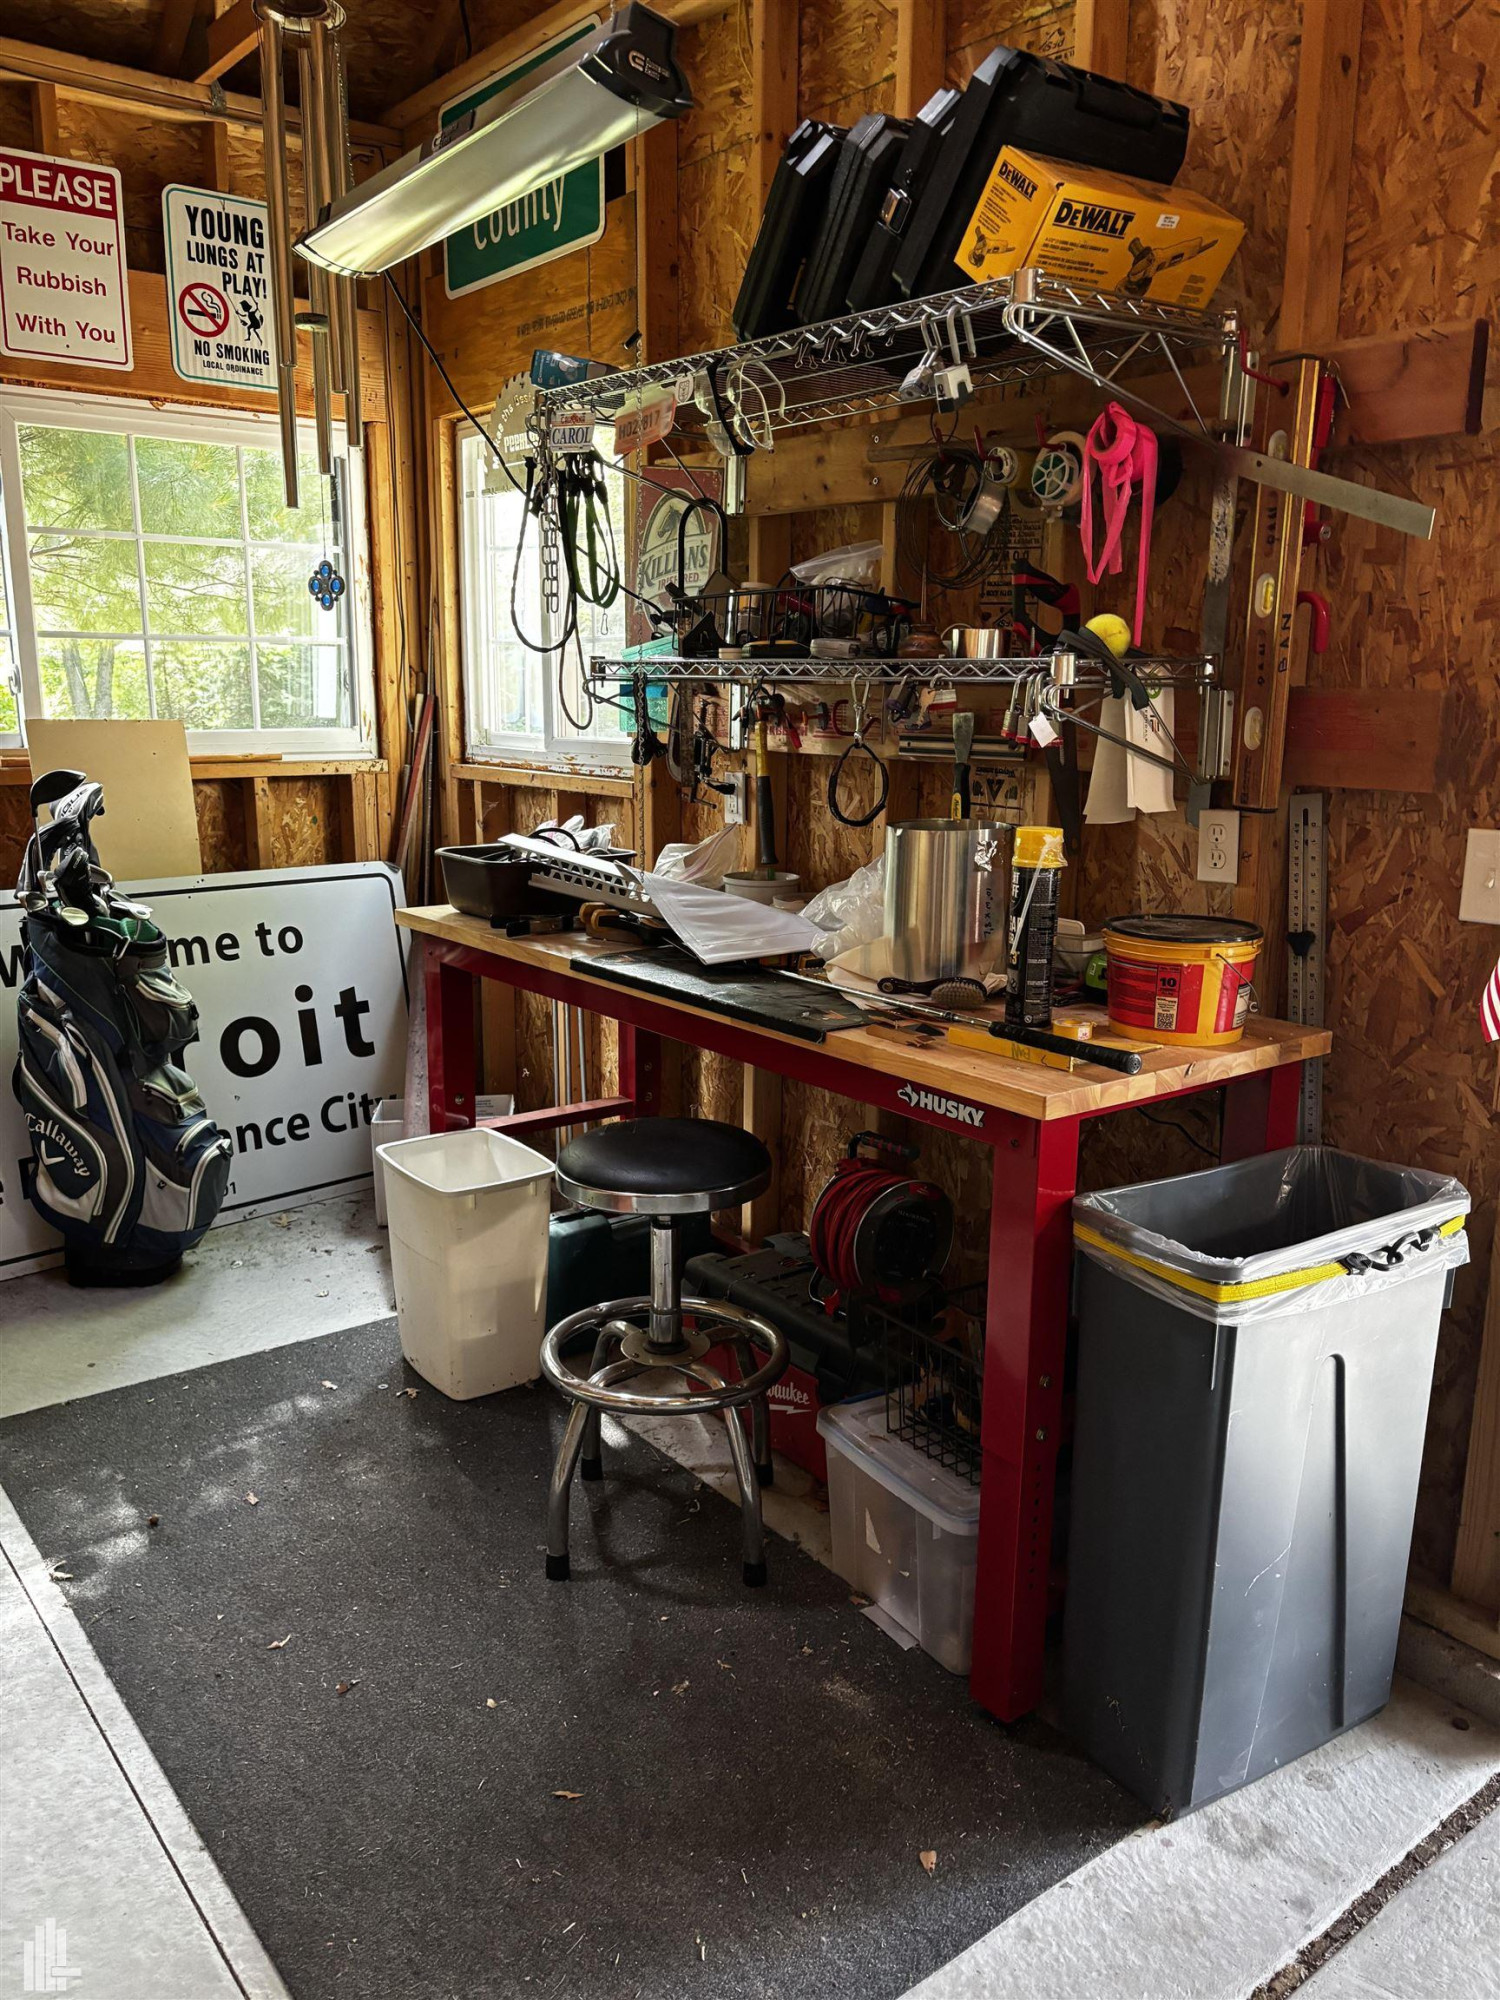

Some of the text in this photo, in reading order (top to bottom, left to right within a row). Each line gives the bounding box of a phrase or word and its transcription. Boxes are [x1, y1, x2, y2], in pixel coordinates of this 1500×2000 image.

[0, 164, 113, 212] PLEASE
[2, 221, 114, 257] Take Your
[184, 204, 265, 249] YOUNG
[187, 240, 265, 274] LUNGS AT
[17, 266, 107, 297] Rubbish
[222, 272, 268, 299] PLAY!
[15, 313, 116, 344] With You
[194, 340, 270, 366] NO SMOKING
[203, 361, 264, 376] LOCAL ORDINANCE
[552, 427, 591, 445] CAROL
[641, 540, 709, 587] KILLIN'S
[255, 922, 304, 959] to
[1159, 977, 1177, 989] 10
[321, 1092, 397, 1133] Cit
[919, 1091, 984, 1127] HUSKY
[24, 1112, 91, 1178] Callaway
